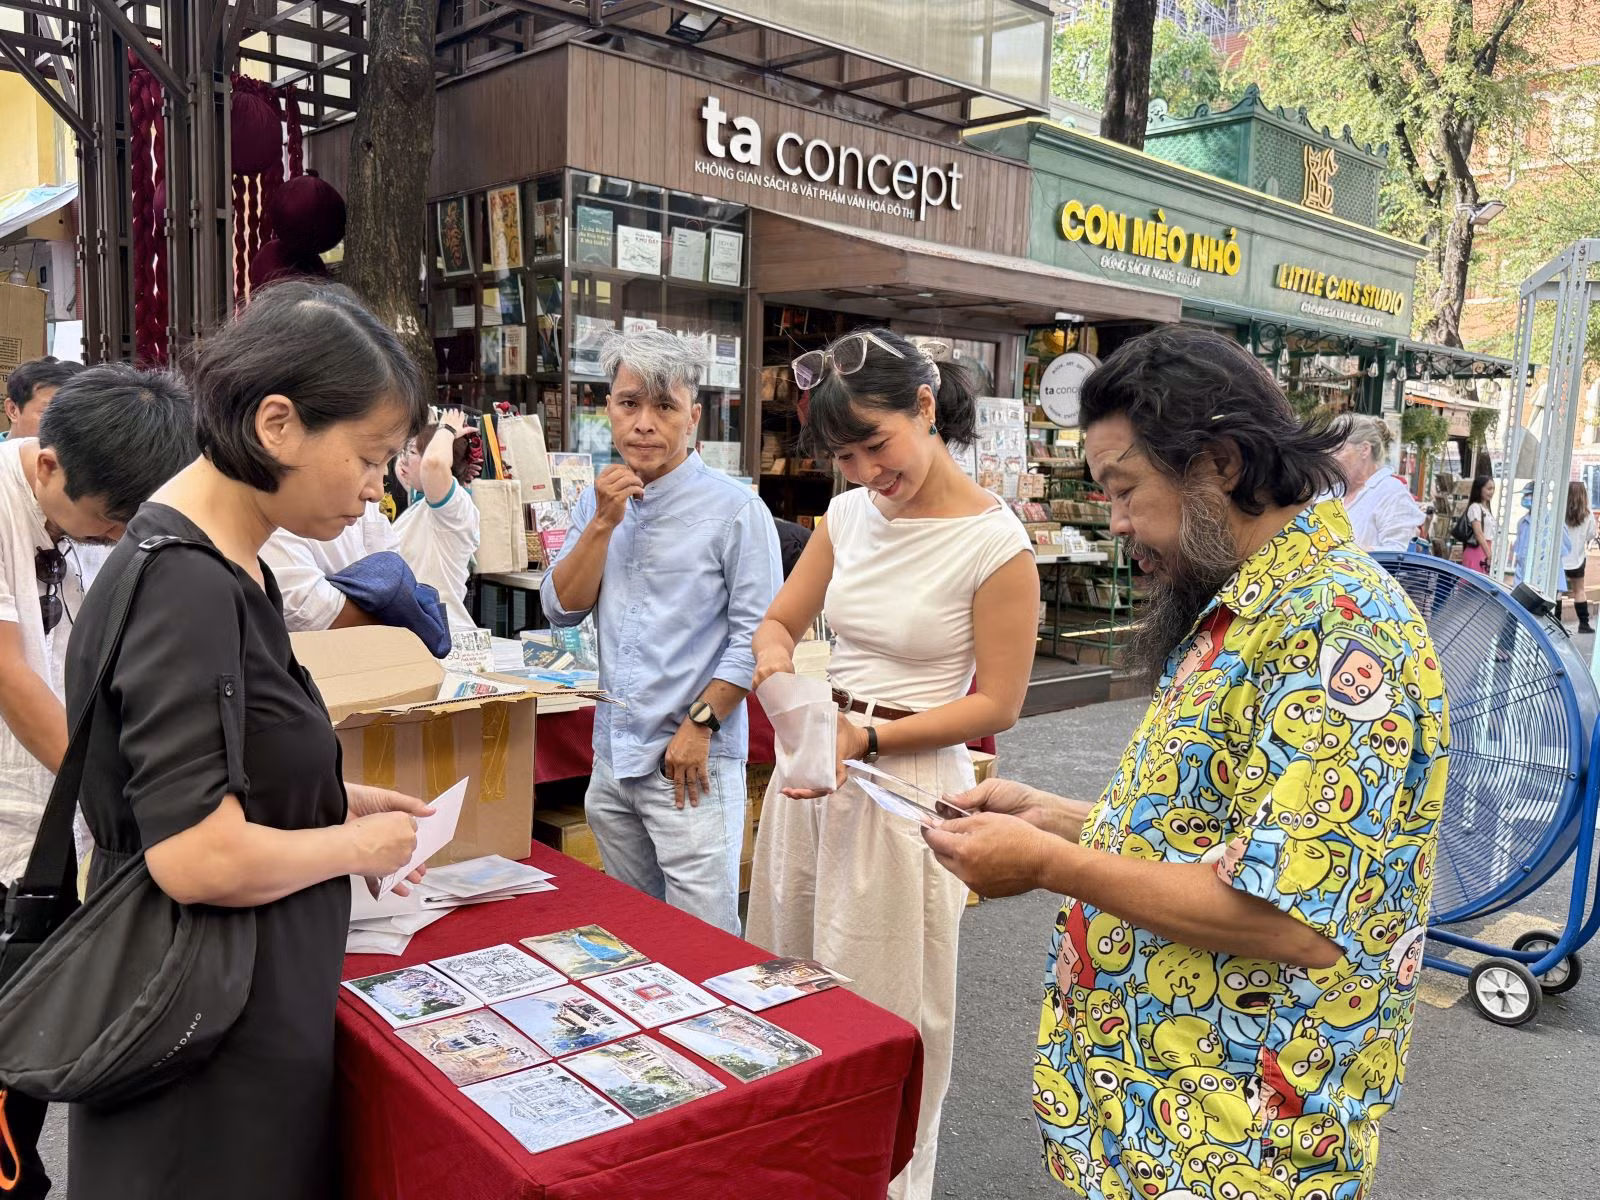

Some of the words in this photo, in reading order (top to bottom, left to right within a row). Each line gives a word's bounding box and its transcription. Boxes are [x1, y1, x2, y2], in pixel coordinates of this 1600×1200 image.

[701, 95, 762, 166] ta
[776, 131, 964, 221] concept
[694, 159, 735, 180] KHÔNG
[736, 168, 762, 186] GIAN
[763, 172, 790, 193] SÁCH
[791, 183, 799, 194] &
[799, 181, 818, 201] VẬT
[819, 186, 846, 206] PHẨM
[846, 191, 866, 210] VĂN
[866, 195, 887, 213] HOÁ
[887, 201, 902, 216] ĐÔ
[1061, 199, 1127, 252] CON
[1132, 208, 1188, 264] MÈO
[1190, 227, 1242, 277] NHỎ
[1279, 263, 1326, 296] LITTLE
[1326, 274, 1361, 304] CATS
[1361, 284, 1405, 316] STUDIO
[1045, 386, 1055, 395] ta
[1055, 386, 1080, 395] conc
[152, 1012, 202, 1068] GIORDANO
